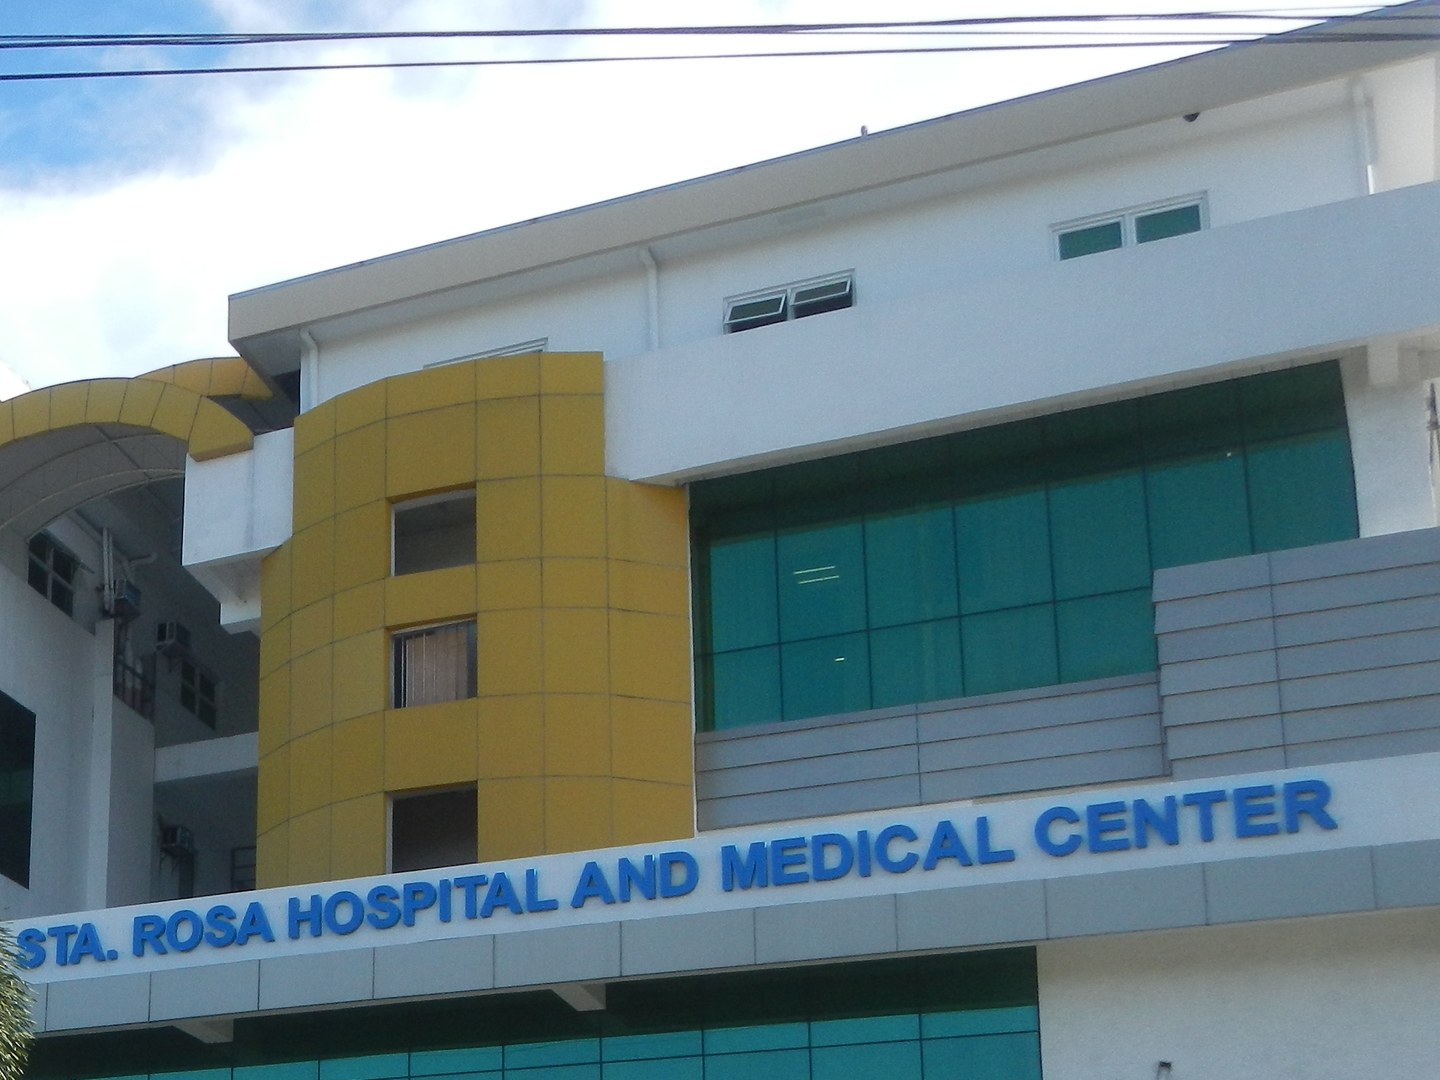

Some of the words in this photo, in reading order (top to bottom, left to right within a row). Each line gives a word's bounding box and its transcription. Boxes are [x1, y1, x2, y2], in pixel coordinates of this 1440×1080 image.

[16, 922, 119, 969] STA.
[133, 901, 276, 958] ROSA
[288, 868, 559, 940] HOSPITAL
[571, 850, 700, 908] AND
[721, 815, 1016, 893] MEDICAL
[1034, 779, 1339, 858] CENTER
